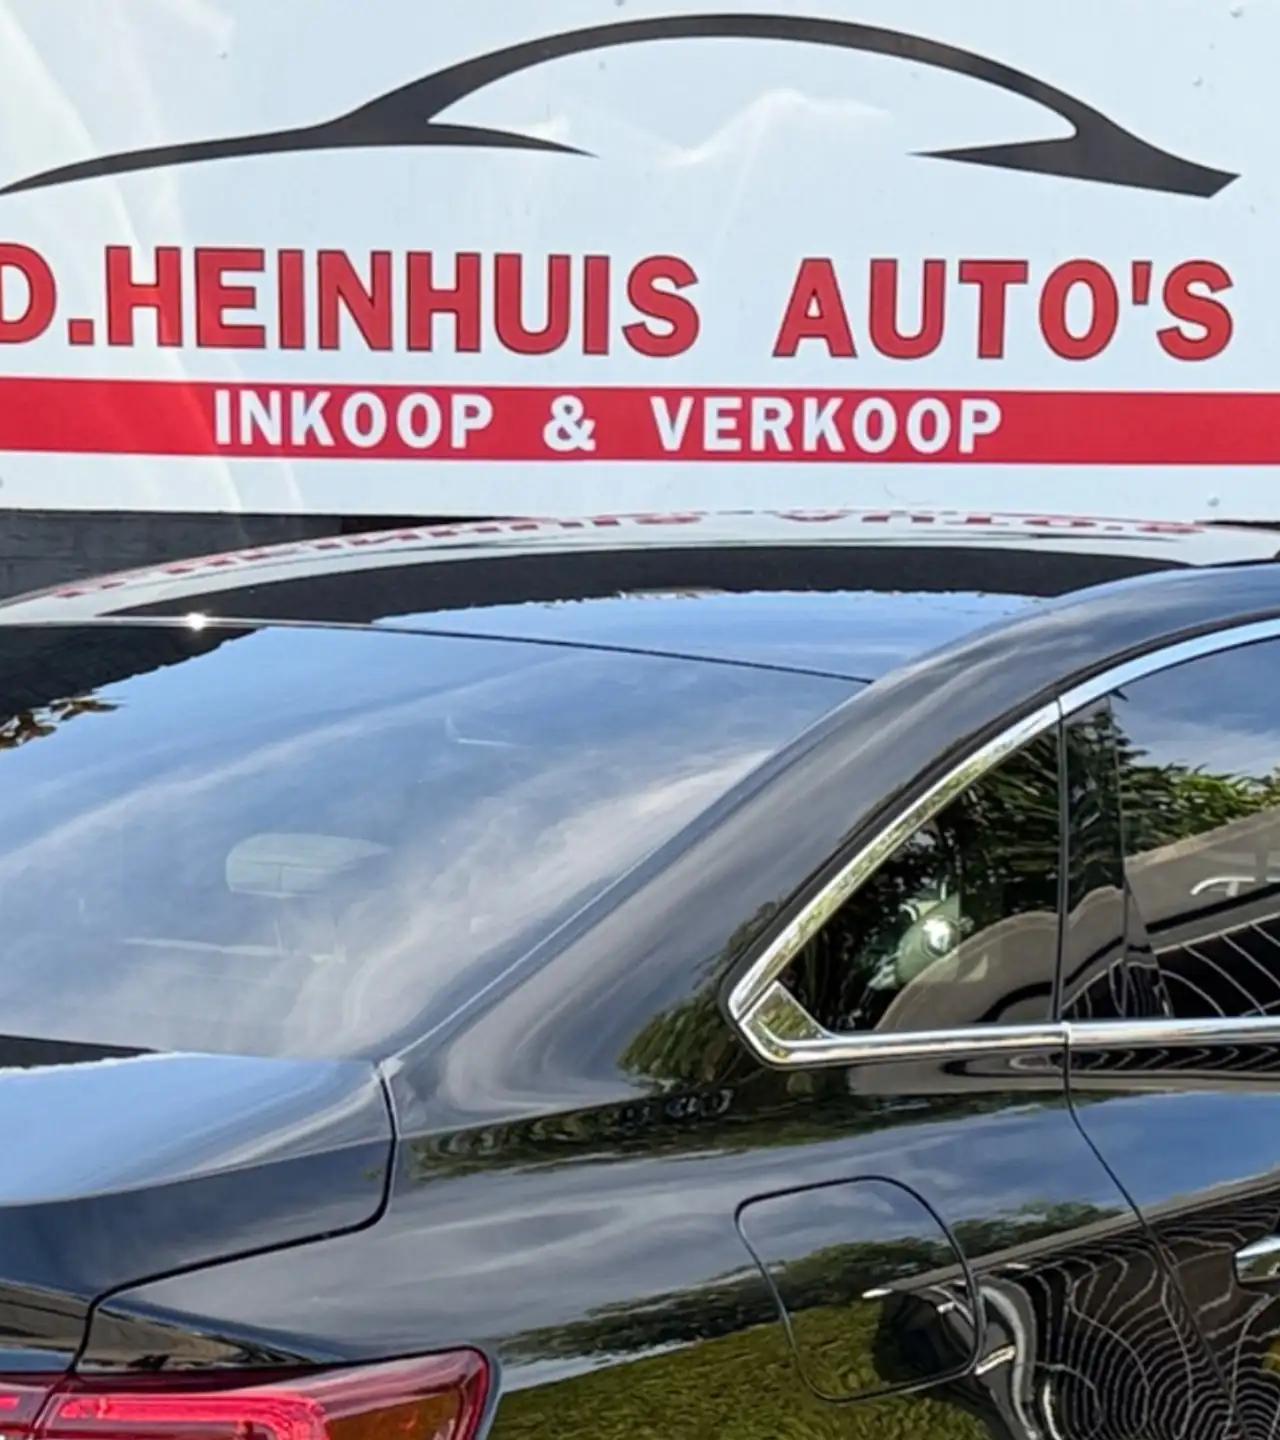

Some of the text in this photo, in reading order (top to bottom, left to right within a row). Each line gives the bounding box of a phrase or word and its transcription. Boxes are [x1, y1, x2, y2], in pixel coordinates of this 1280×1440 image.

[772, 258, 1234, 361] AUTO'S
[215, 389, 1002, 453] INKOOP & VERKOOP
